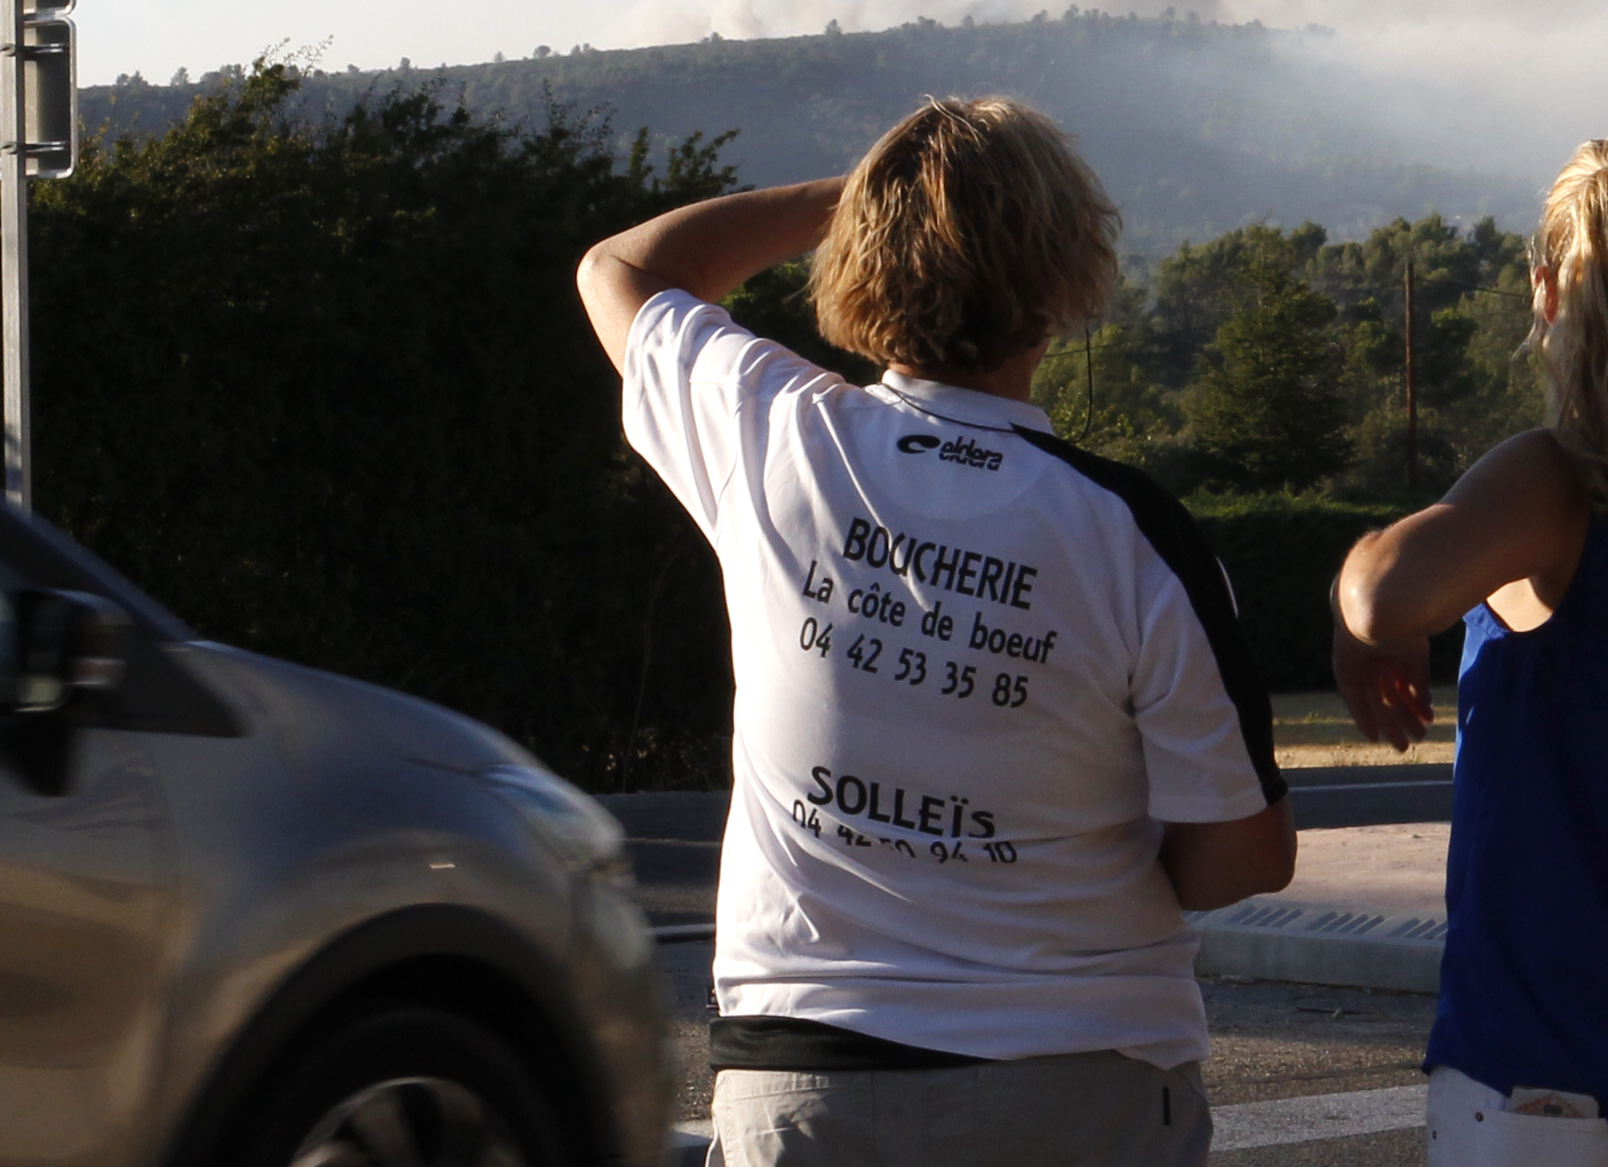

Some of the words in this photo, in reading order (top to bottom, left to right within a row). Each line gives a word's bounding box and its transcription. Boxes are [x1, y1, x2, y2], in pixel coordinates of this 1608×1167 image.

[843, 516, 1038, 611] BOUCHERIE
[802, 559, 835, 604] La
[847, 581, 906, 627] côte
[921, 600, 954, 642] de
[968, 611, 1058, 664] boeuf
[800, 616, 834, 658] 04
[846, 633, 883, 674] 42
[894, 647, 927, 686] 53
[941, 661, 977, 699] 35
[992, 672, 1029, 709] 85
